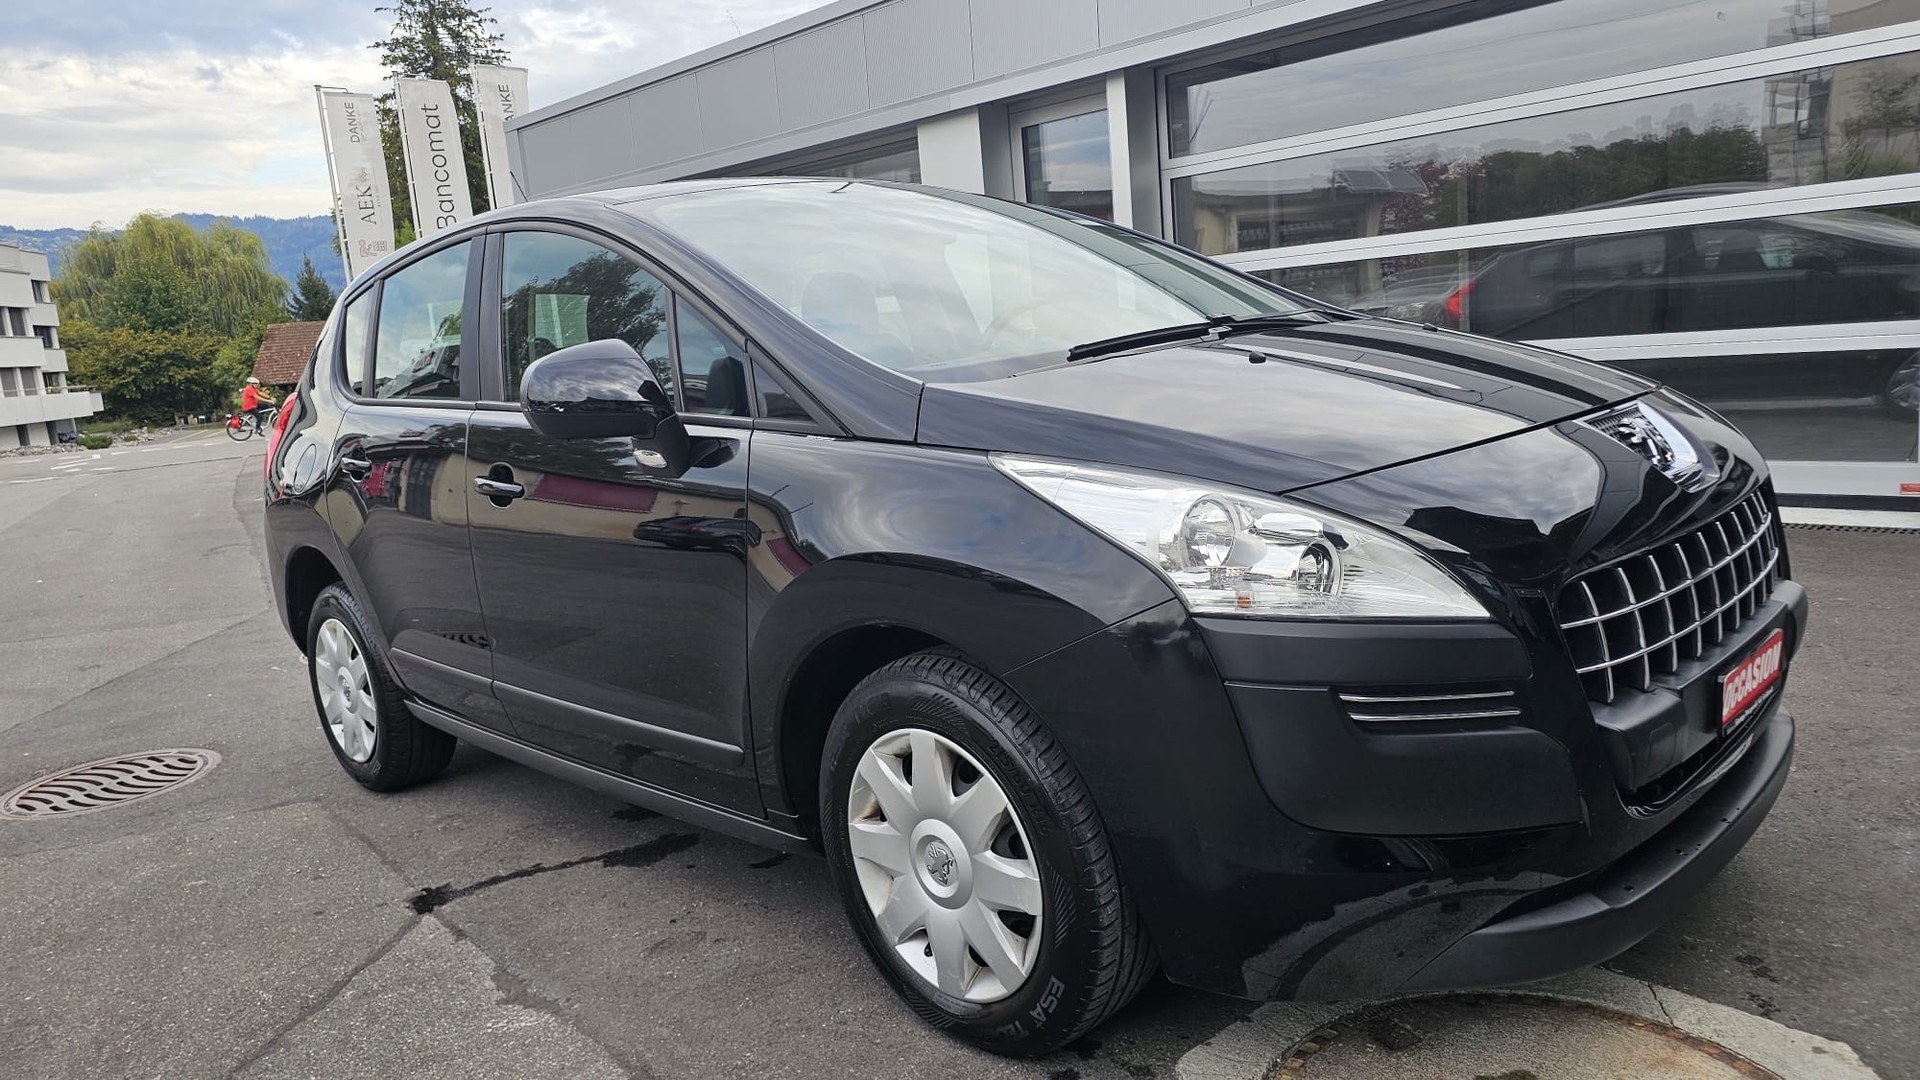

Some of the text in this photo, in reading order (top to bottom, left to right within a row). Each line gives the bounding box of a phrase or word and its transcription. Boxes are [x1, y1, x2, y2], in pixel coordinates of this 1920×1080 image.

[344, 101, 361, 143] DANKE
[498, 83, 515, 122] ANKE
[420, 103, 457, 229] Bancomat
[355, 184, 377, 225] AEK
[1722, 641, 1782, 715] OCCASION
